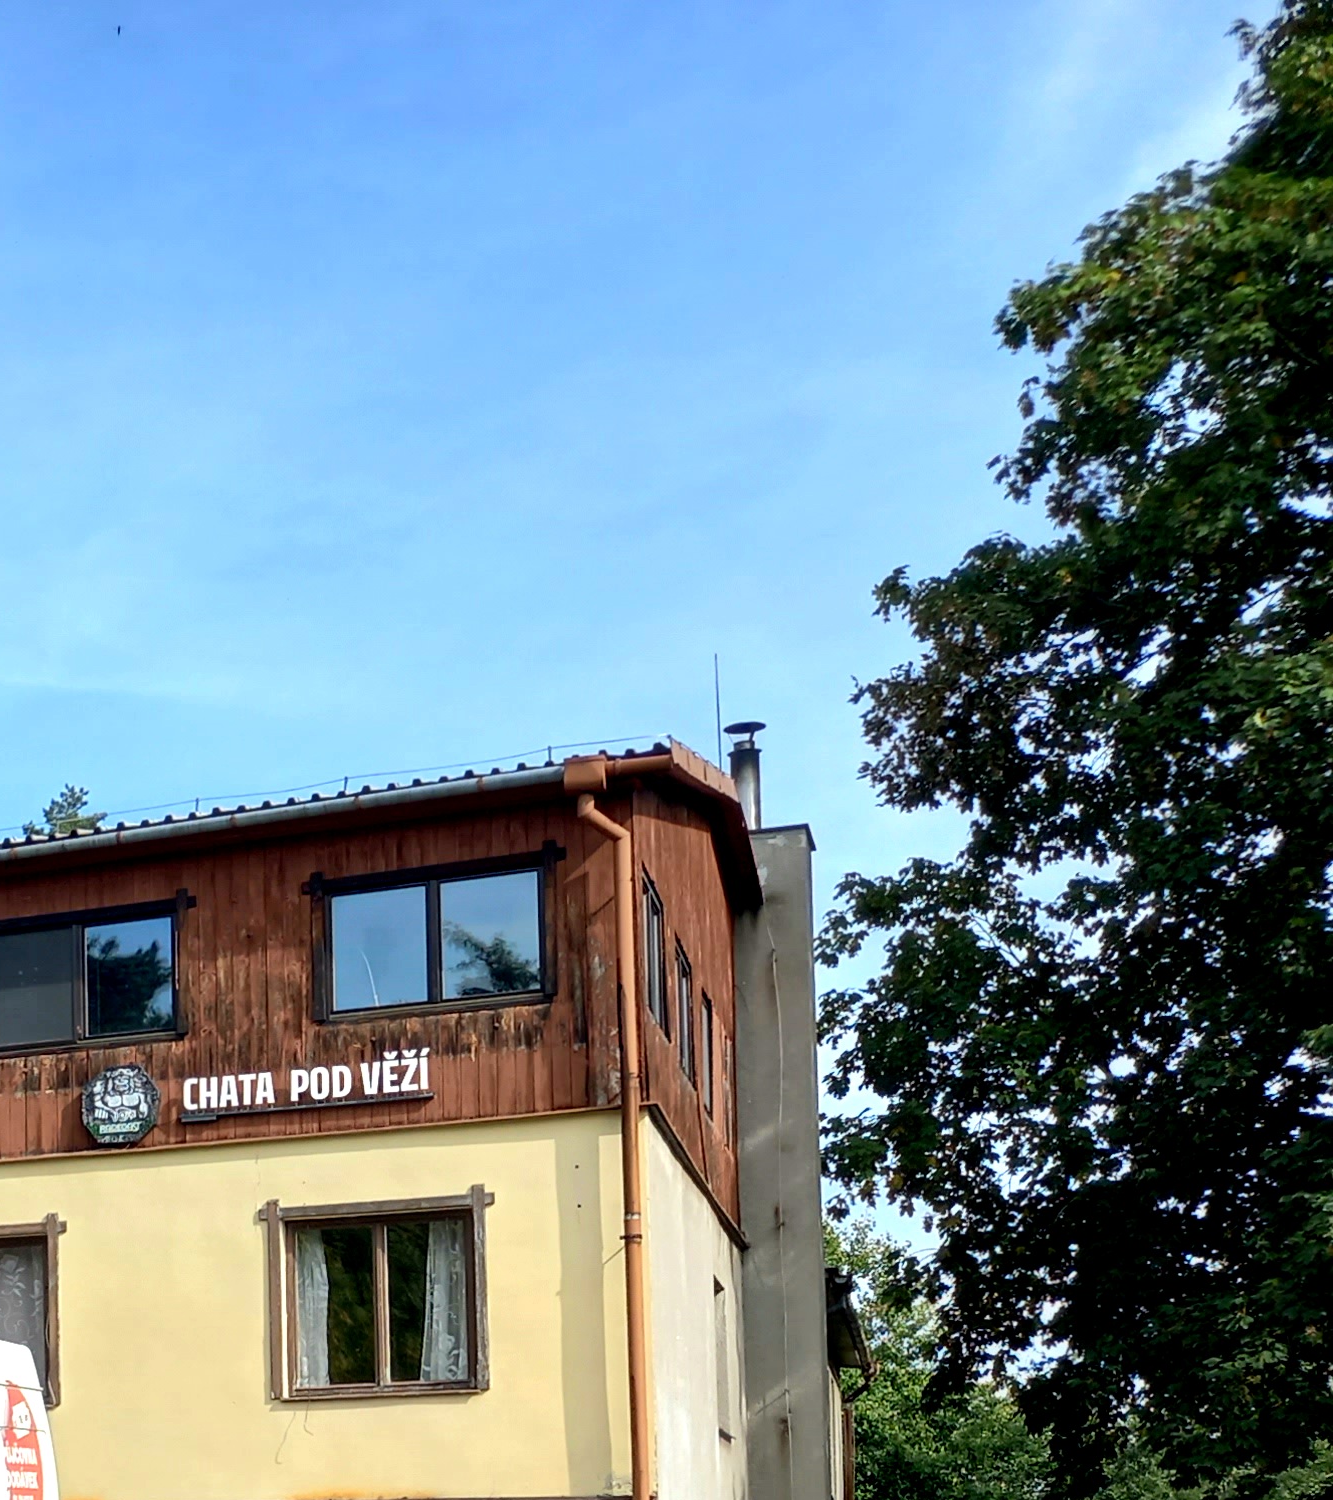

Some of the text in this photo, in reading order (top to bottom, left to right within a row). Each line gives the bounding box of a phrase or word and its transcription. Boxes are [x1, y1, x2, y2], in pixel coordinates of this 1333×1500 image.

[183, 1047, 430, 1110] CHATA POD VĚŽÍ
